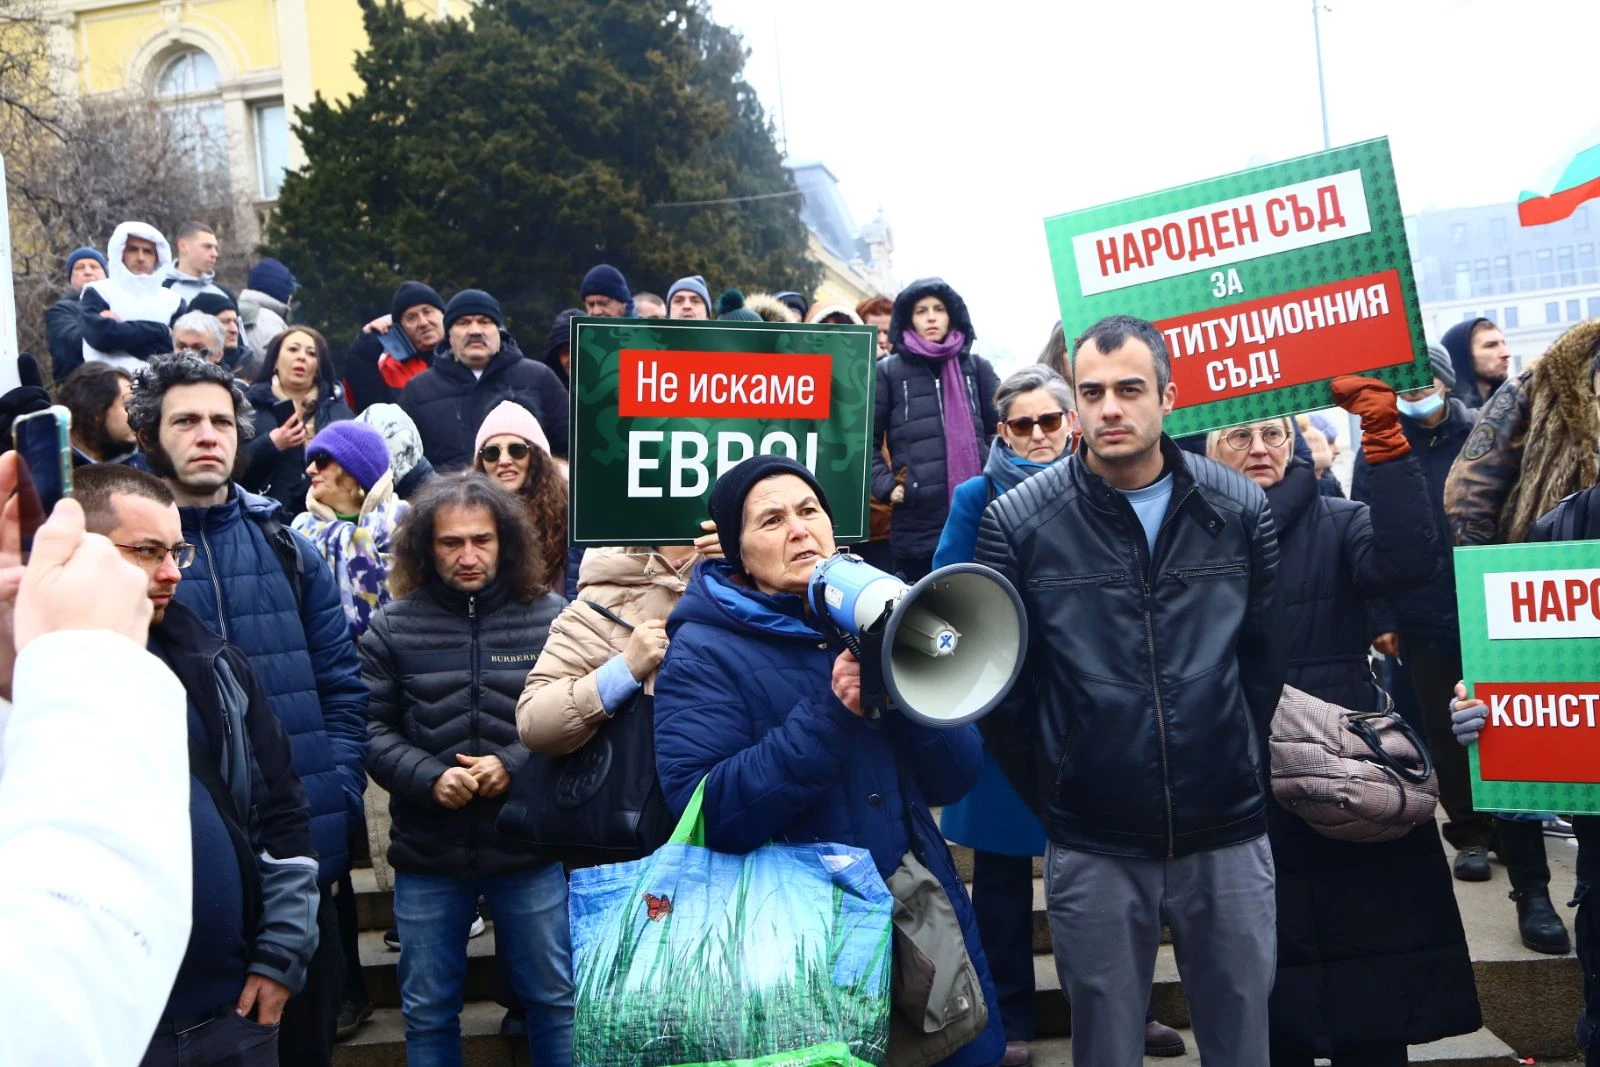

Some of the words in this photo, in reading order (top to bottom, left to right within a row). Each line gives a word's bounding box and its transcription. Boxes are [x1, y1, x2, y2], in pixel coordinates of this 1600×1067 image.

[1096, 204, 1258, 276] НАРОДЕН
[1266, 185, 1346, 237] СЪД
[1210, 268, 1244, 298] ЗА
[1160, 283, 1390, 359] ТИТУЦИОННИЯ
[637, 361, 678, 403] Не
[689, 372, 815, 405] искаме
[1206, 349, 1281, 392] СЪД!
[491, 654, 540, 663] BURBERR
[1490, 694, 1600, 728] КОНСТ
